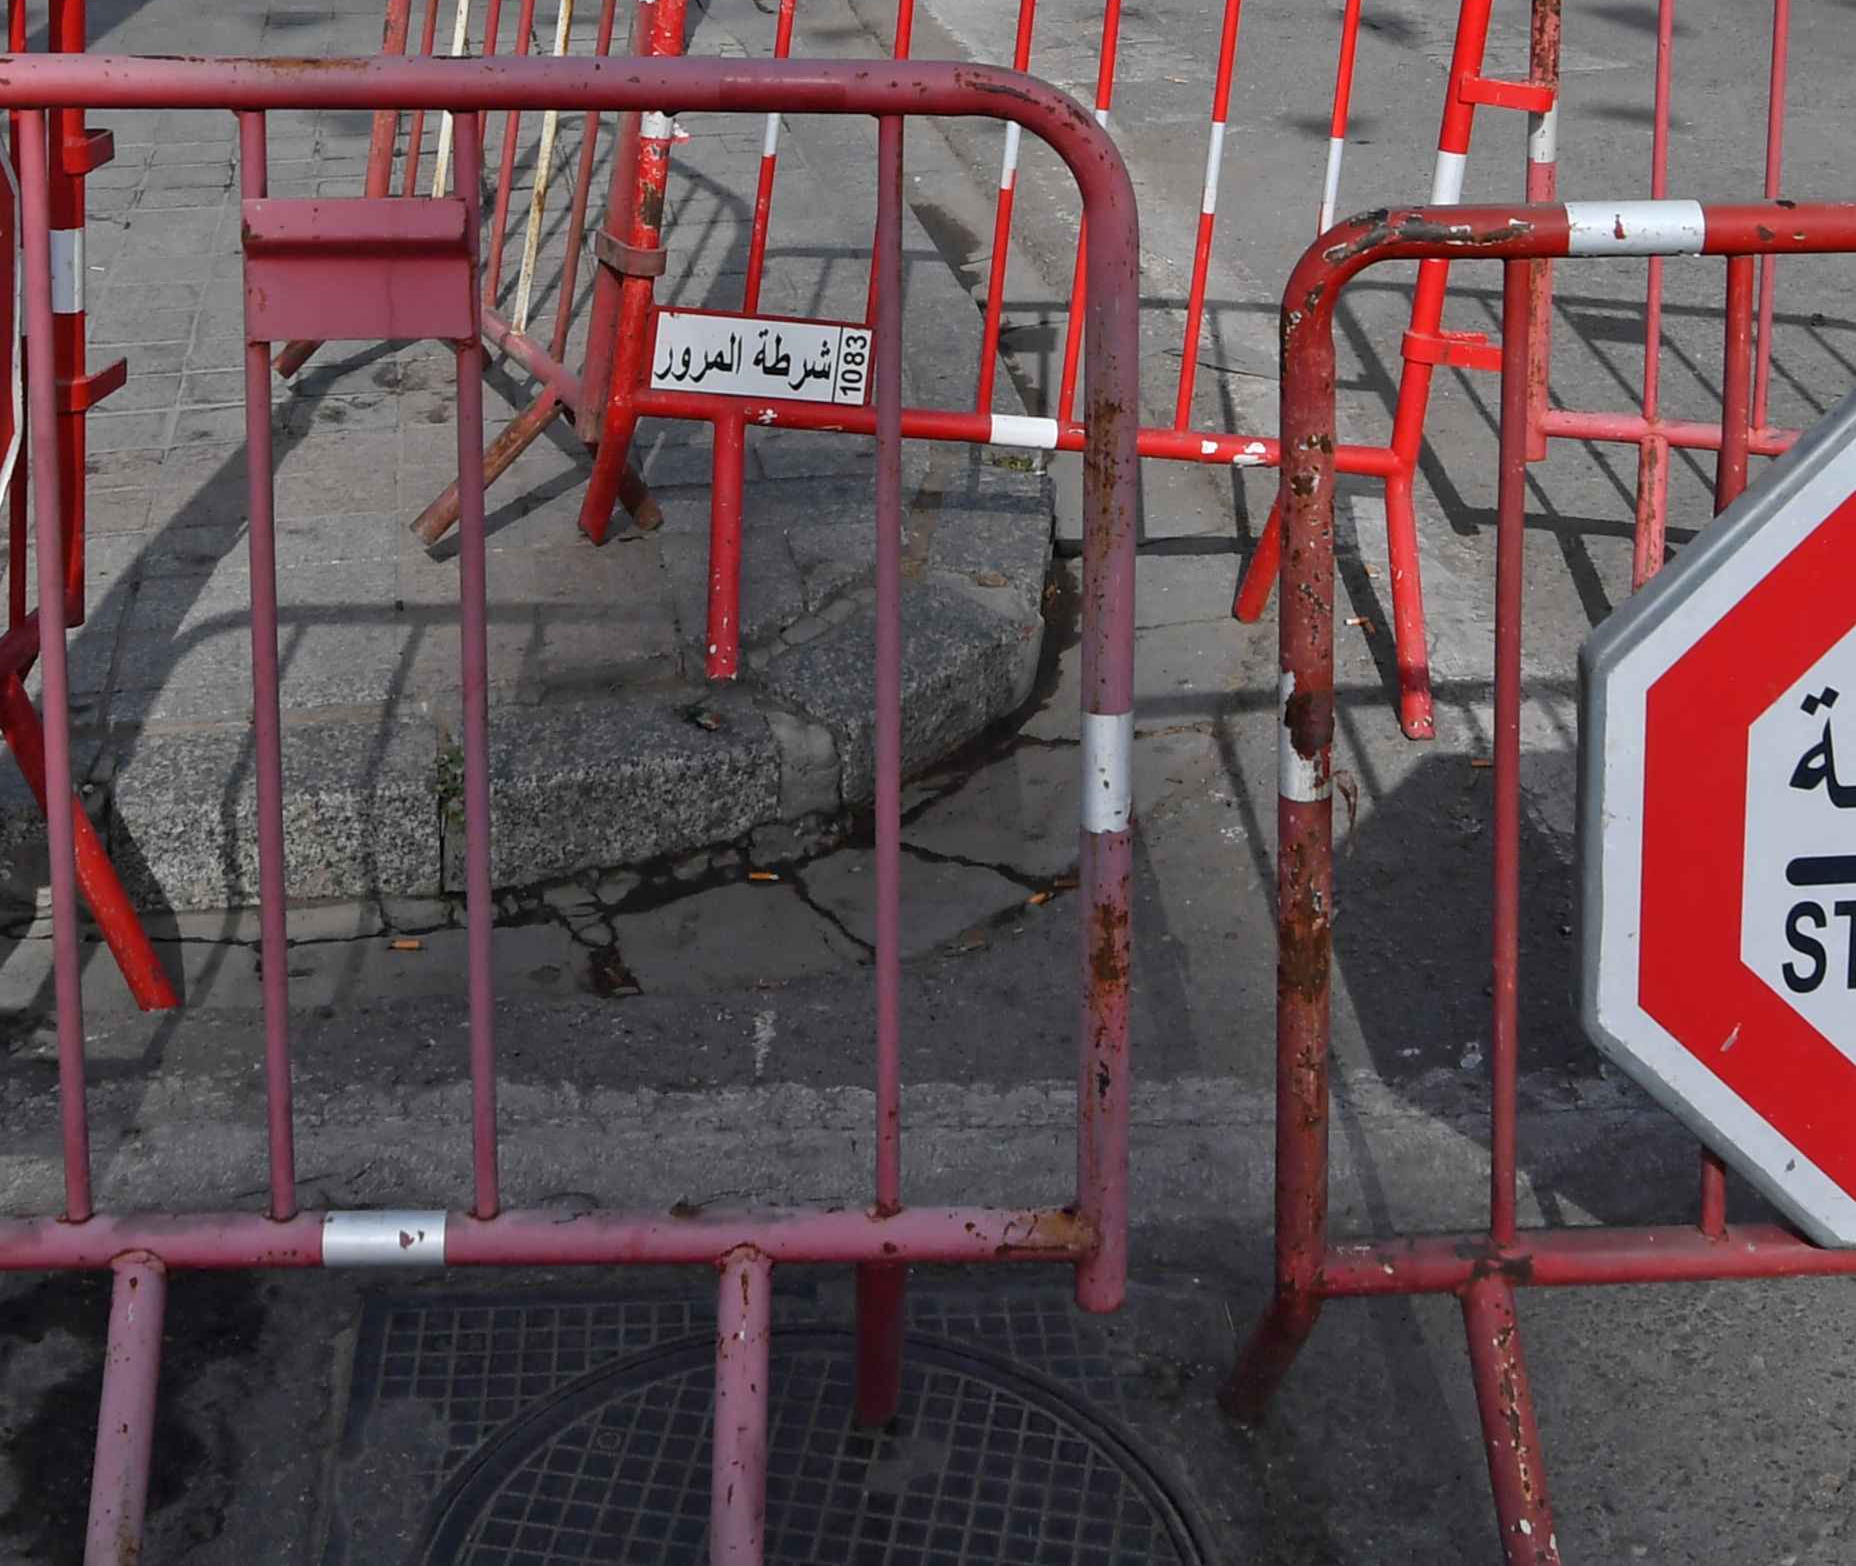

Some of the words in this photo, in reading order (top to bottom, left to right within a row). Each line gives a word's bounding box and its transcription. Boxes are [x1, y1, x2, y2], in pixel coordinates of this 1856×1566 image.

[653, 331, 744, 384] المرور
[752, 327, 833, 392] شرطة
[840, 335, 868, 396] 1083
